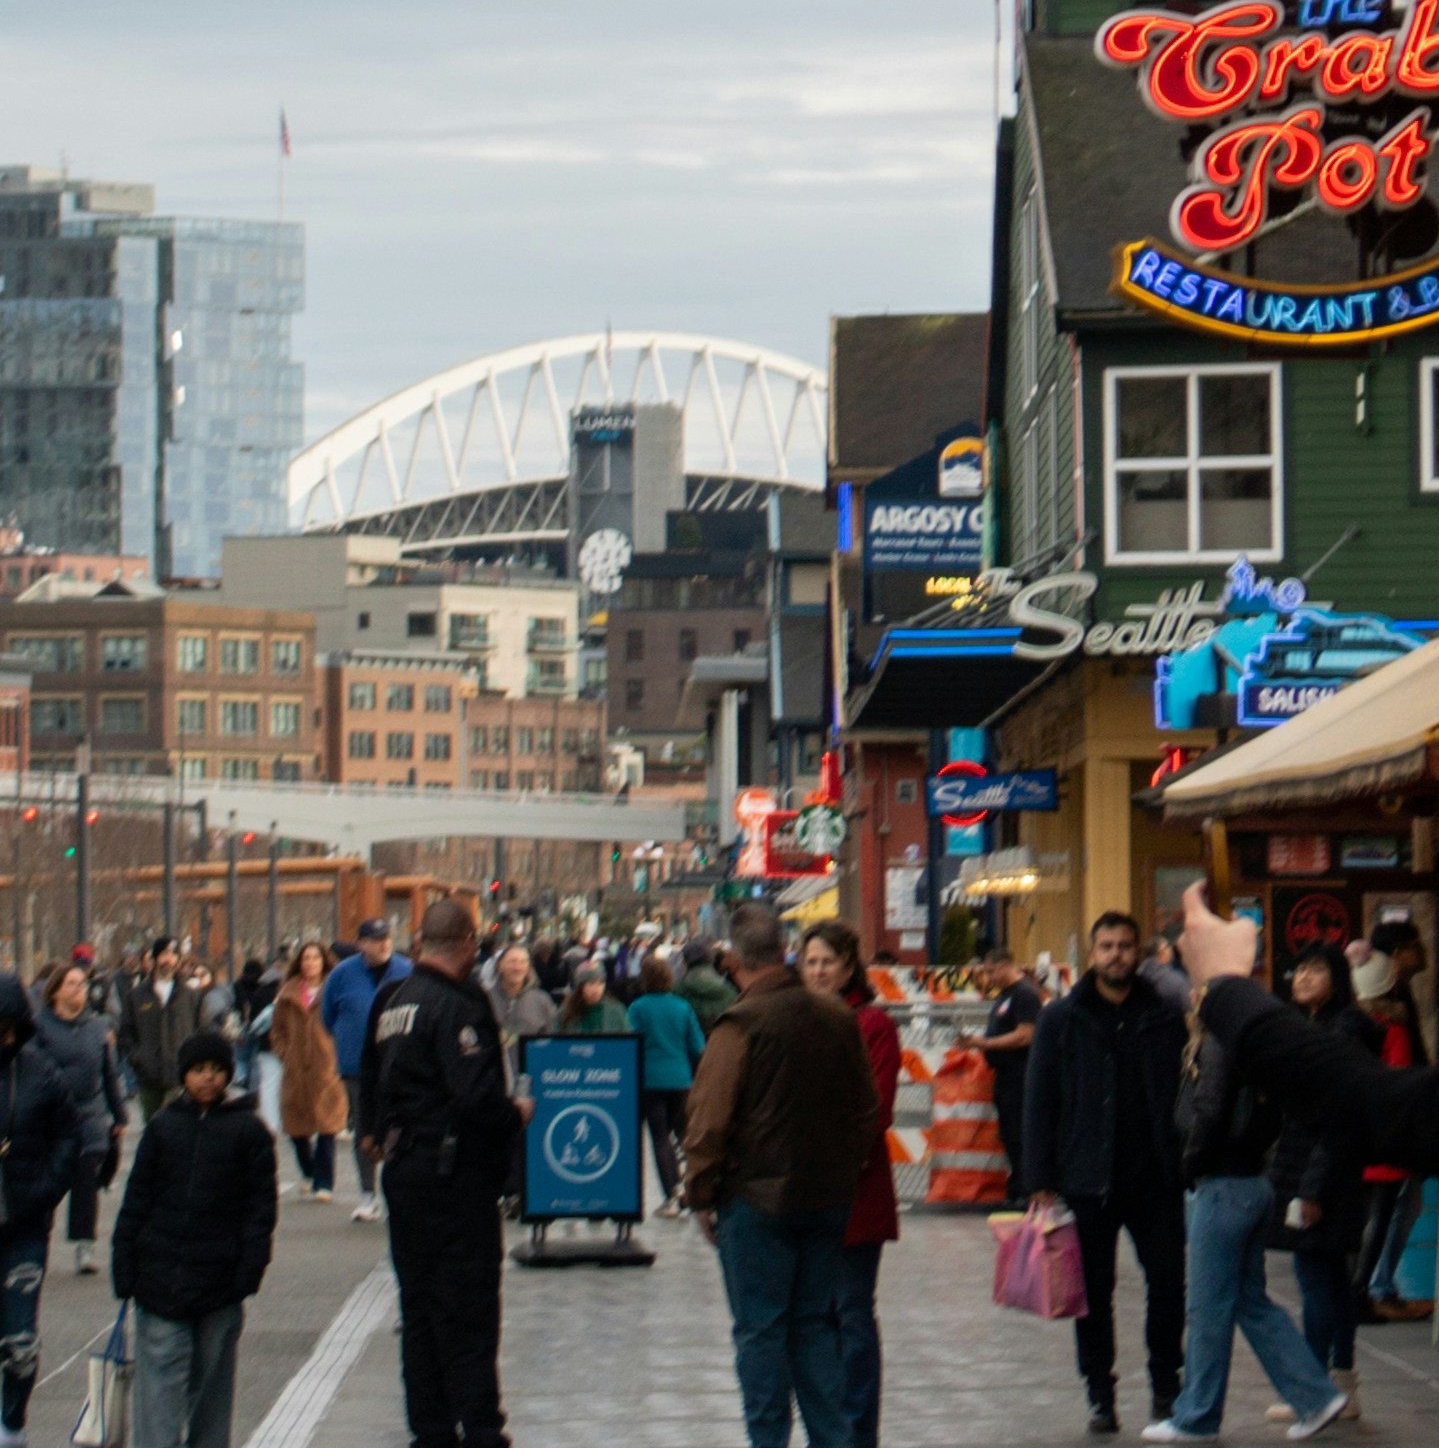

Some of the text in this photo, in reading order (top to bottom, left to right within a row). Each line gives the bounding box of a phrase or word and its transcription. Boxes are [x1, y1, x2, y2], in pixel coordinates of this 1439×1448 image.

[1169, 104, 1433, 249] Pot
[1131, 249, 1378, 333] RESTAURANT
[870, 505, 968, 535] ARGOSY
[1009, 571, 1222, 661] Seattle
